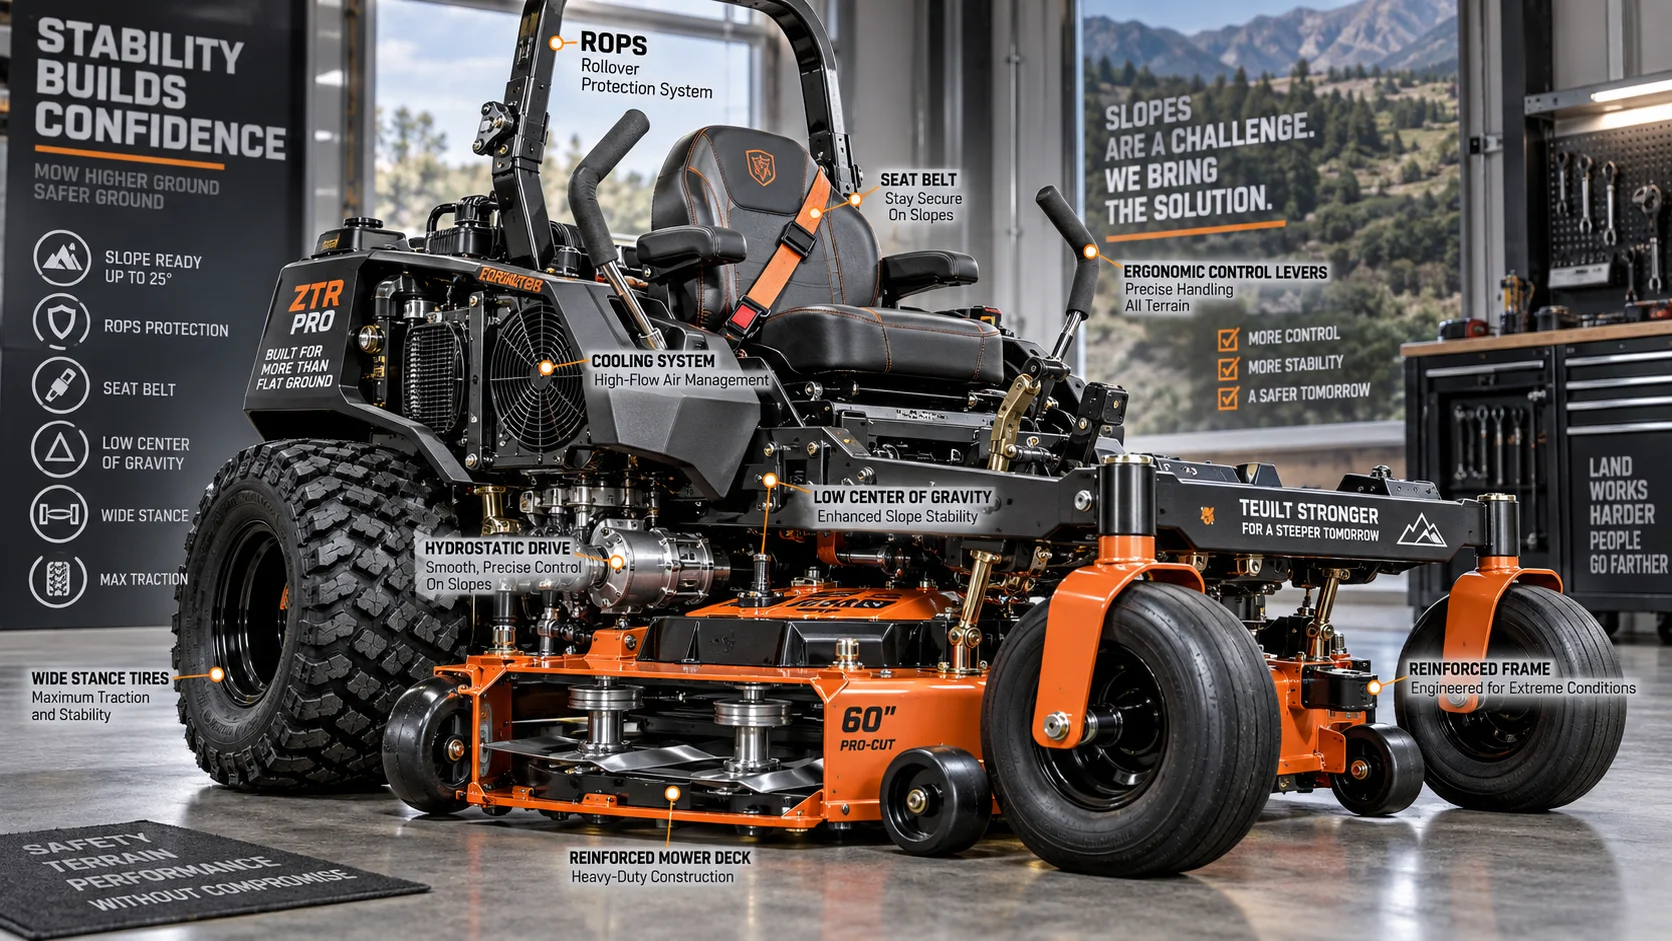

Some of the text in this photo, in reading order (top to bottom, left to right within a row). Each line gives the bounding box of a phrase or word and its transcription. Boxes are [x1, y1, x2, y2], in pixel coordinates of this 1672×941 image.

[37, 16, 245, 75] STABILITY
[36, 58, 187, 110] BUILDS
[1105, 95, 1192, 131] SLOPES
[35, 100, 286, 161] CONFIDENCE
[1104, 112, 1315, 162] ARE A CHALLENGE.
[34, 162, 220, 196] MOW HIGHER GROUND
[1105, 156, 1218, 193] WE BRING
[34, 183, 164, 210] SAFER GROUND
[1105, 184, 1273, 225] THE SOLUTION.
[105, 250, 202, 270] SLOPE READY
[105, 269, 172, 286] UP TO 25°
[288, 279, 345, 312] ZTR
[104, 319, 229, 337] ROPS PROTECTION
[290, 309, 336, 335] PRO
[1248, 325, 1341, 346] MORE CONTROL
[265, 345, 323, 361] BUILT FOR
[261, 359, 330, 376] MORE THAN
[1248, 354, 1344, 375] MORE STABILITY
[103, 381, 176, 397] SEAT BELT
[256, 374, 333, 391] FLAT GROUND
[1248, 382, 1371, 403] A SAFER TOMORROW
[102, 436, 190, 451] LOW CENTER
[102, 455, 185, 470] OF GRAVITY
[1589, 456, 1633, 478] LAND
[1589, 479, 1648, 501] WORKS
[101, 509, 189, 522] WIDE STANCE
[1297, 502, 1379, 525] STRONGER
[1590, 503, 1655, 526] HARDER
[1242, 522, 1379, 542] FOR A STEEPER TOMORROW
[1590, 530, 1642, 550] PEOPLE
[1590, 554, 1669, 574] GO FARTHER
[100, 573, 188, 586] MAX TRACTION
[840, 739, 896, 751] PRO-CUT
[22, 832, 152, 856] SAFETY
[41, 848, 178, 873] TERRAIN
[65, 855, 282, 892] PERFORMANCE
[87, 869, 358, 912] WITHOUT COMPROMISE
